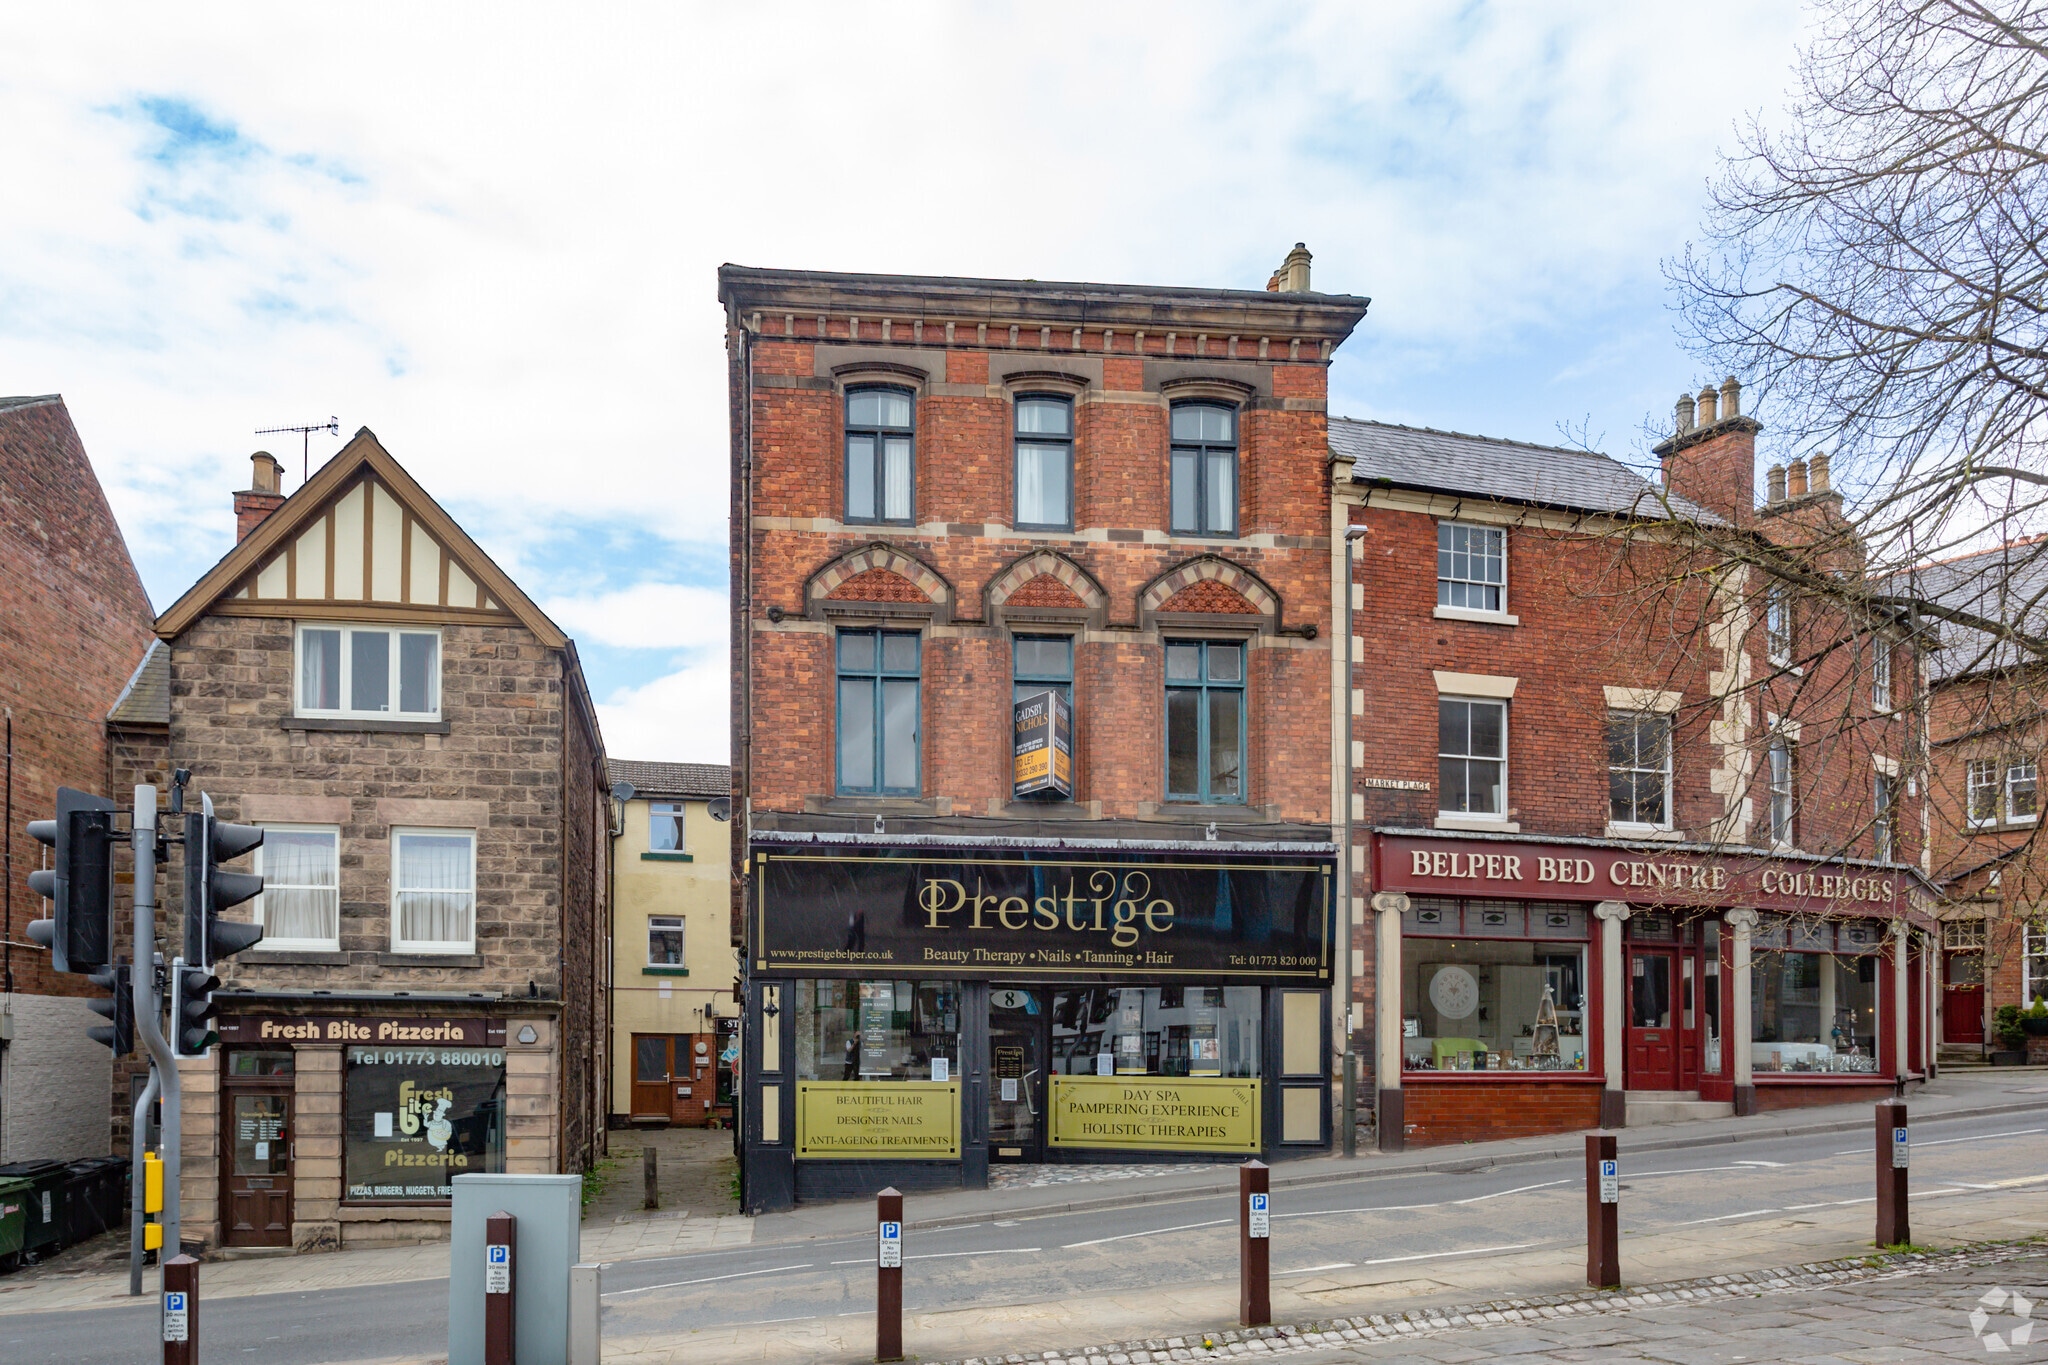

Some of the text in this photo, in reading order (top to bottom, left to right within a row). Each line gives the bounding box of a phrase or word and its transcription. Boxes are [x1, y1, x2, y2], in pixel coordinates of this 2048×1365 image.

[1016, 703, 1043, 722] GADSBY
[1016, 713, 1048, 734] NICHOLS
[1016, 755, 1034, 768] TO LET
[1368, 779, 1429, 790] MARKET PLACE
[1411, 850, 1523, 881] BELPER
[1538, 856, 1595, 884] BED
[1610, 860, 1726, 890] CENTRE
[1762, 869, 1892, 902] COLLEDGES
[919, 870, 1174, 947] Prestige
[770, 949, 894, 961] www.prestigebelper.co.uk
[924, 948, 1174, 966] Beauty Therapy Nails Tanning Hair
[1229, 955, 1316, 966] Tel: 01773 820 000
[1005, 991, 1015, 1007] 8
[261, 1020, 464, 1040] Fresh Bite Pizzeria
[353, 1051, 501, 1066] Tel 01773 880010
[836, 1096, 923, 1105] BEAUTIFUL HAIR
[1059, 1085, 1077, 1104] RELAX
[1123, 1089, 1181, 1102] DAY SPA
[1232, 1088, 1250, 1106] CHILL
[1070, 1103, 1240, 1118] PAMPERING EXPERIENCE
[837, 1116, 923, 1125] DESIGNER NAILS
[1083, 1123, 1226, 1137] HOLISTIC THERAPIES
[1898, 1130, 1904, 1142] P
[809, 1136, 949, 1145] ANTI-AGEING TREATMENTS
[385, 1148, 467, 1167] Pizzeria
[1606, 1163, 1613, 1175] P
[350, 1185, 373, 1197] PIZZAS,
[374, 1186, 405, 1197] BURGERS,
[406, 1186, 436, 1197] NUGGETS,
[1255, 1197, 1264, 1209] P
[886, 1225, 895, 1237] P
[493, 1249, 503, 1262] P
[170, 1296, 180, 1309] P
